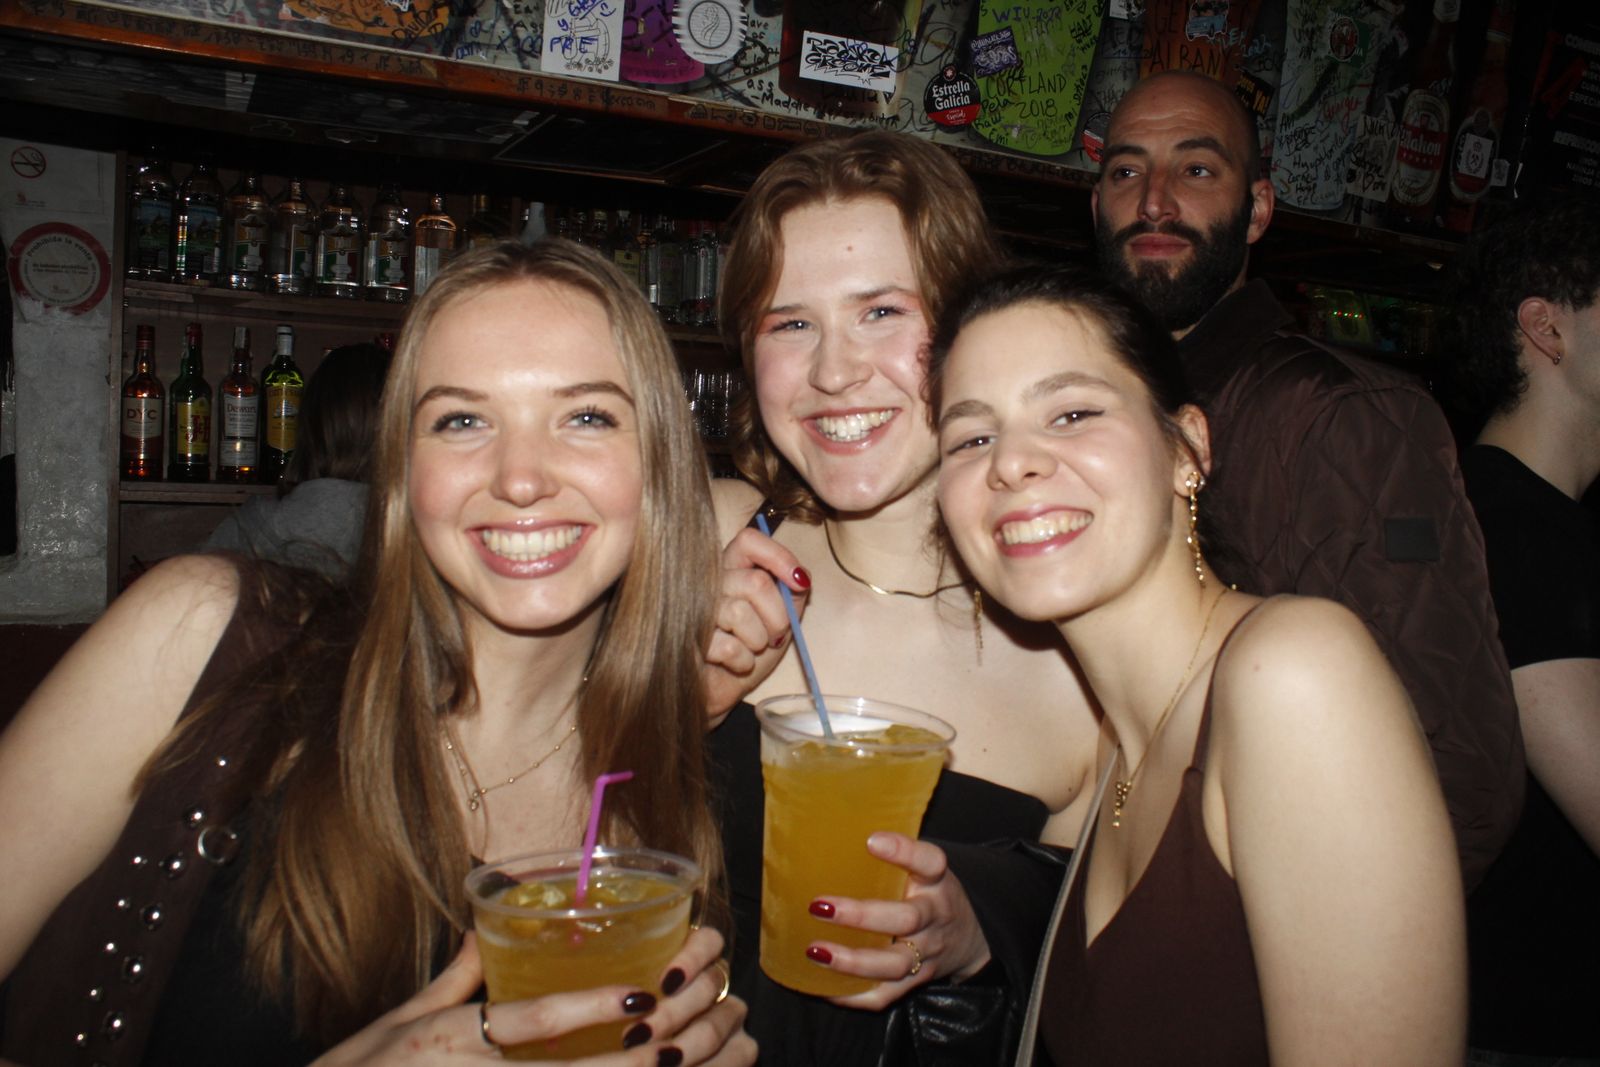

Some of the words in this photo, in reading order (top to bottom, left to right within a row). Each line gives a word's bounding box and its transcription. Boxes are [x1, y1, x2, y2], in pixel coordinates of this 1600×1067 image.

[931, 80, 971, 98] Estrella
[985, 71, 1067, 99] CORTLAND
[934, 93, 971, 111] Galicia
[1016, 98, 1058, 119] 2018
[127, 407, 158, 421] DYC
